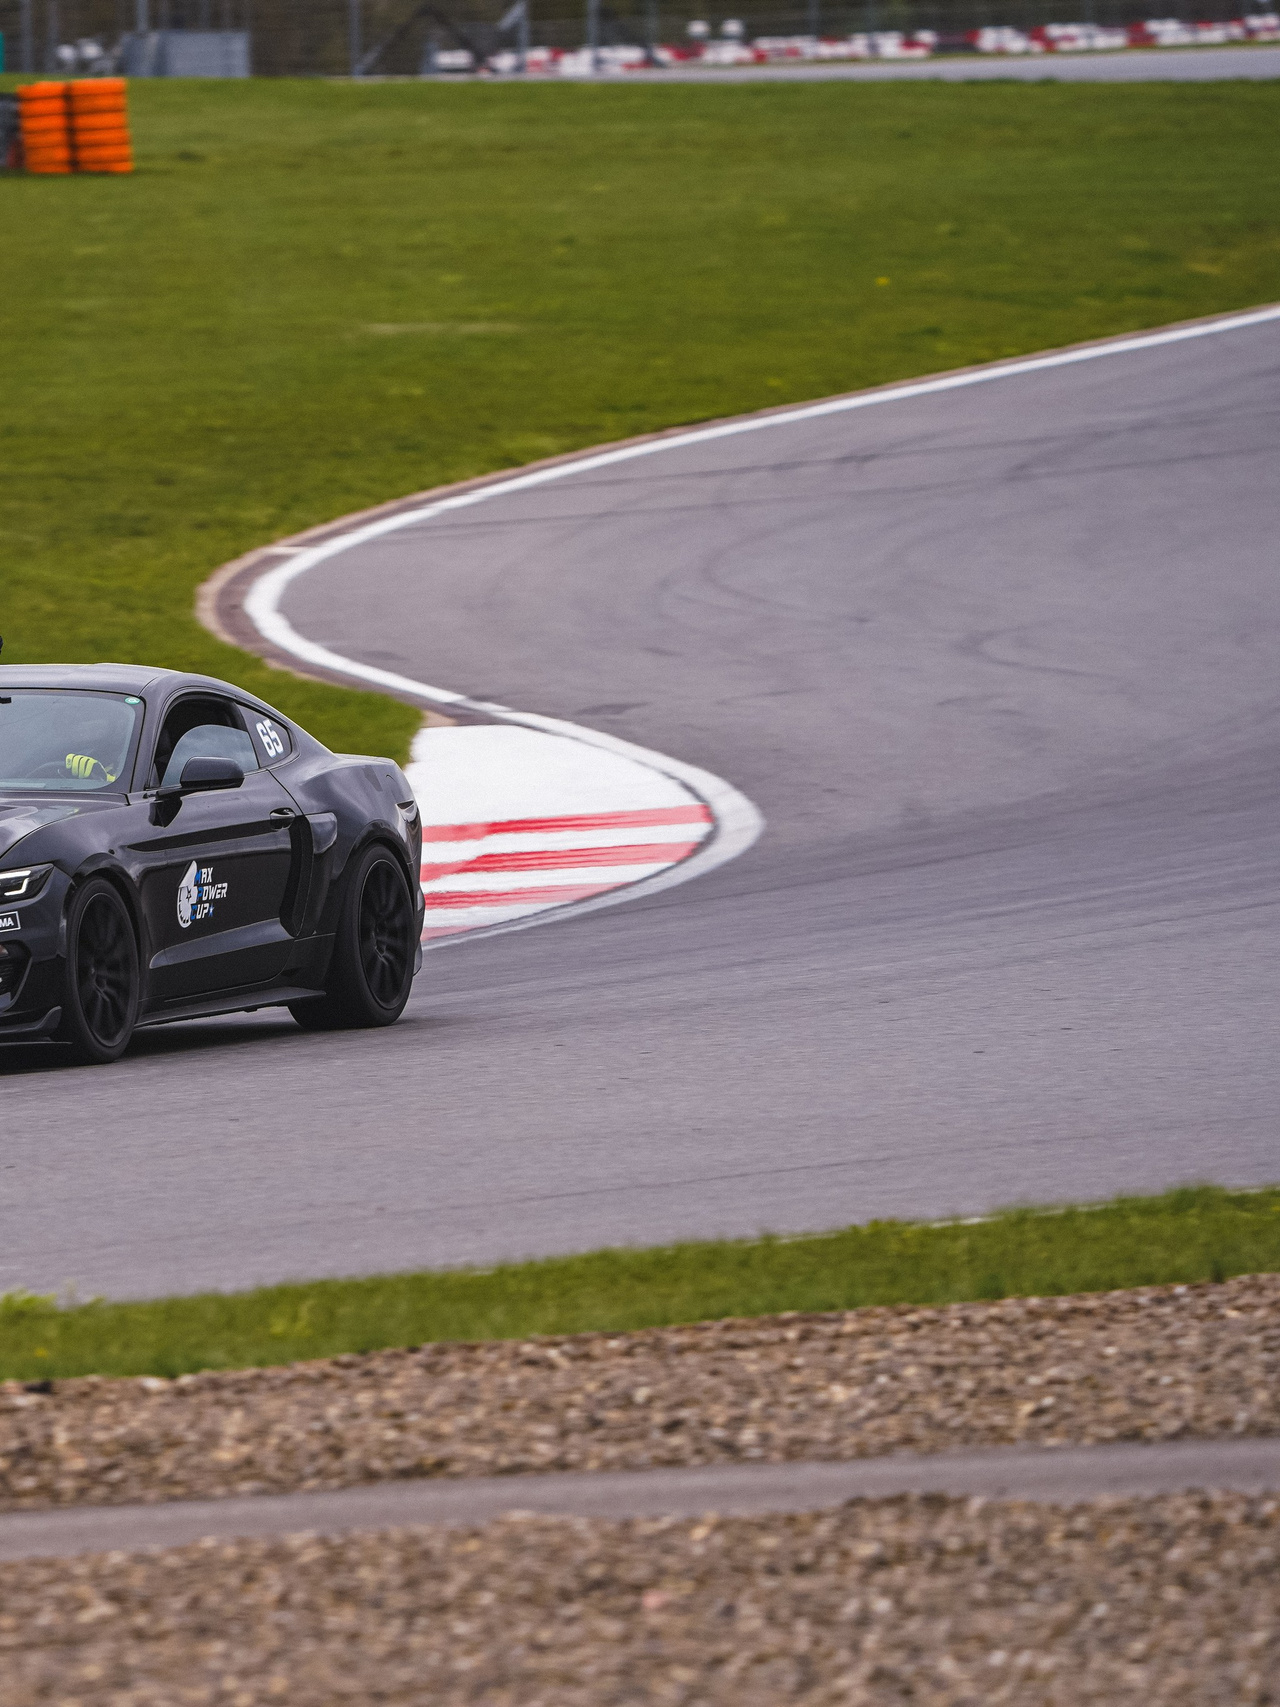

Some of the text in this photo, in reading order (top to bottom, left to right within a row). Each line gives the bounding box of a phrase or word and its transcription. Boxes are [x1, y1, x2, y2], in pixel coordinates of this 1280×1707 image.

[256, 719, 284, 758] 65
[194, 867, 213, 886] MAX
[197, 883, 228, 901] POWER
[190, 903, 210, 920] CUP
